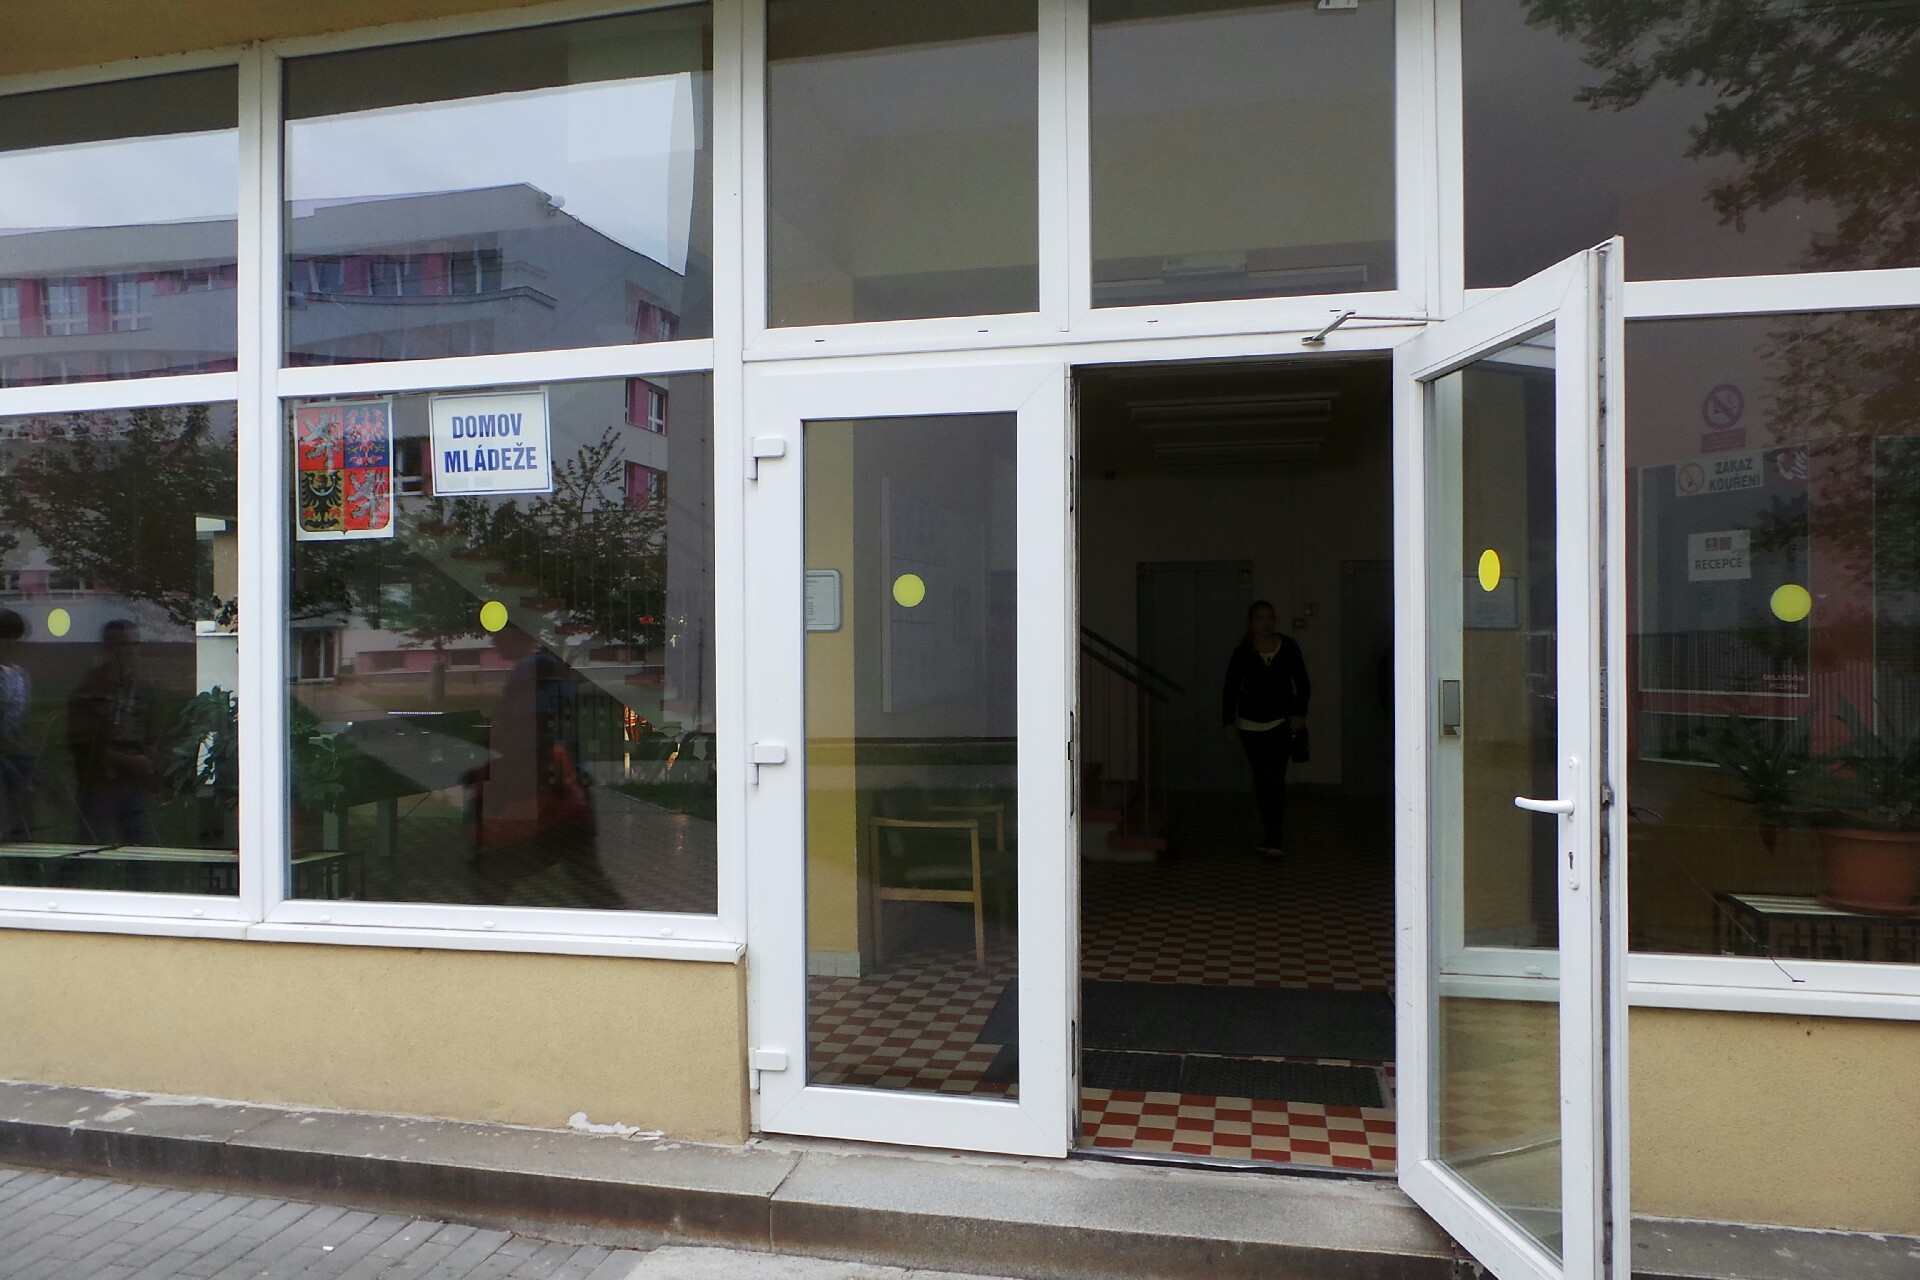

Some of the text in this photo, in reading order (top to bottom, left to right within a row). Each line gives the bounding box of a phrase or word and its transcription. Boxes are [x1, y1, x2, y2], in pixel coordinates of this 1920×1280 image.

[452, 413, 522, 439] DOMOV
[444, 442, 538, 473] MLÁDEŽE
[1695, 557, 1743, 570] RECEPCE
